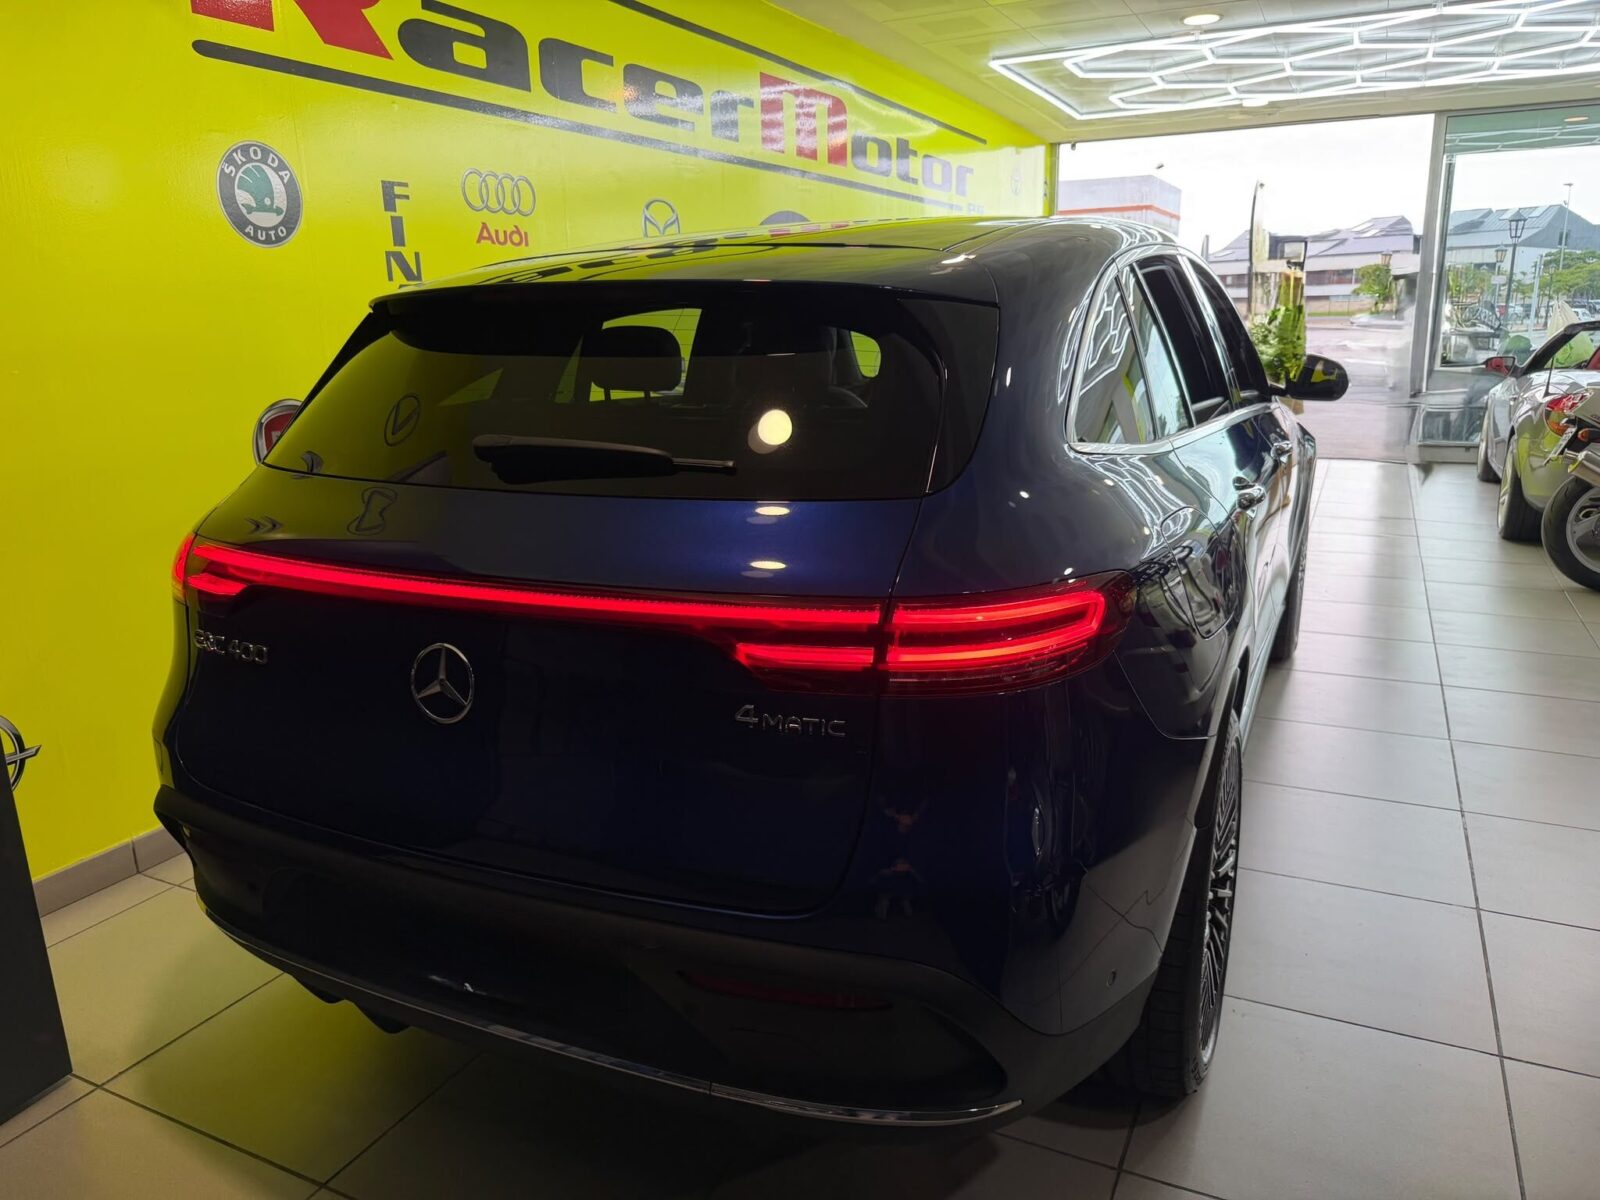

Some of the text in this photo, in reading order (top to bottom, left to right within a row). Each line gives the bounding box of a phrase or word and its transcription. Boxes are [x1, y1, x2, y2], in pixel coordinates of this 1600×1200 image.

[244, 225, 287, 241] AUTO
[475, 221, 529, 248] Audi
[228, 639, 269, 664] 400
